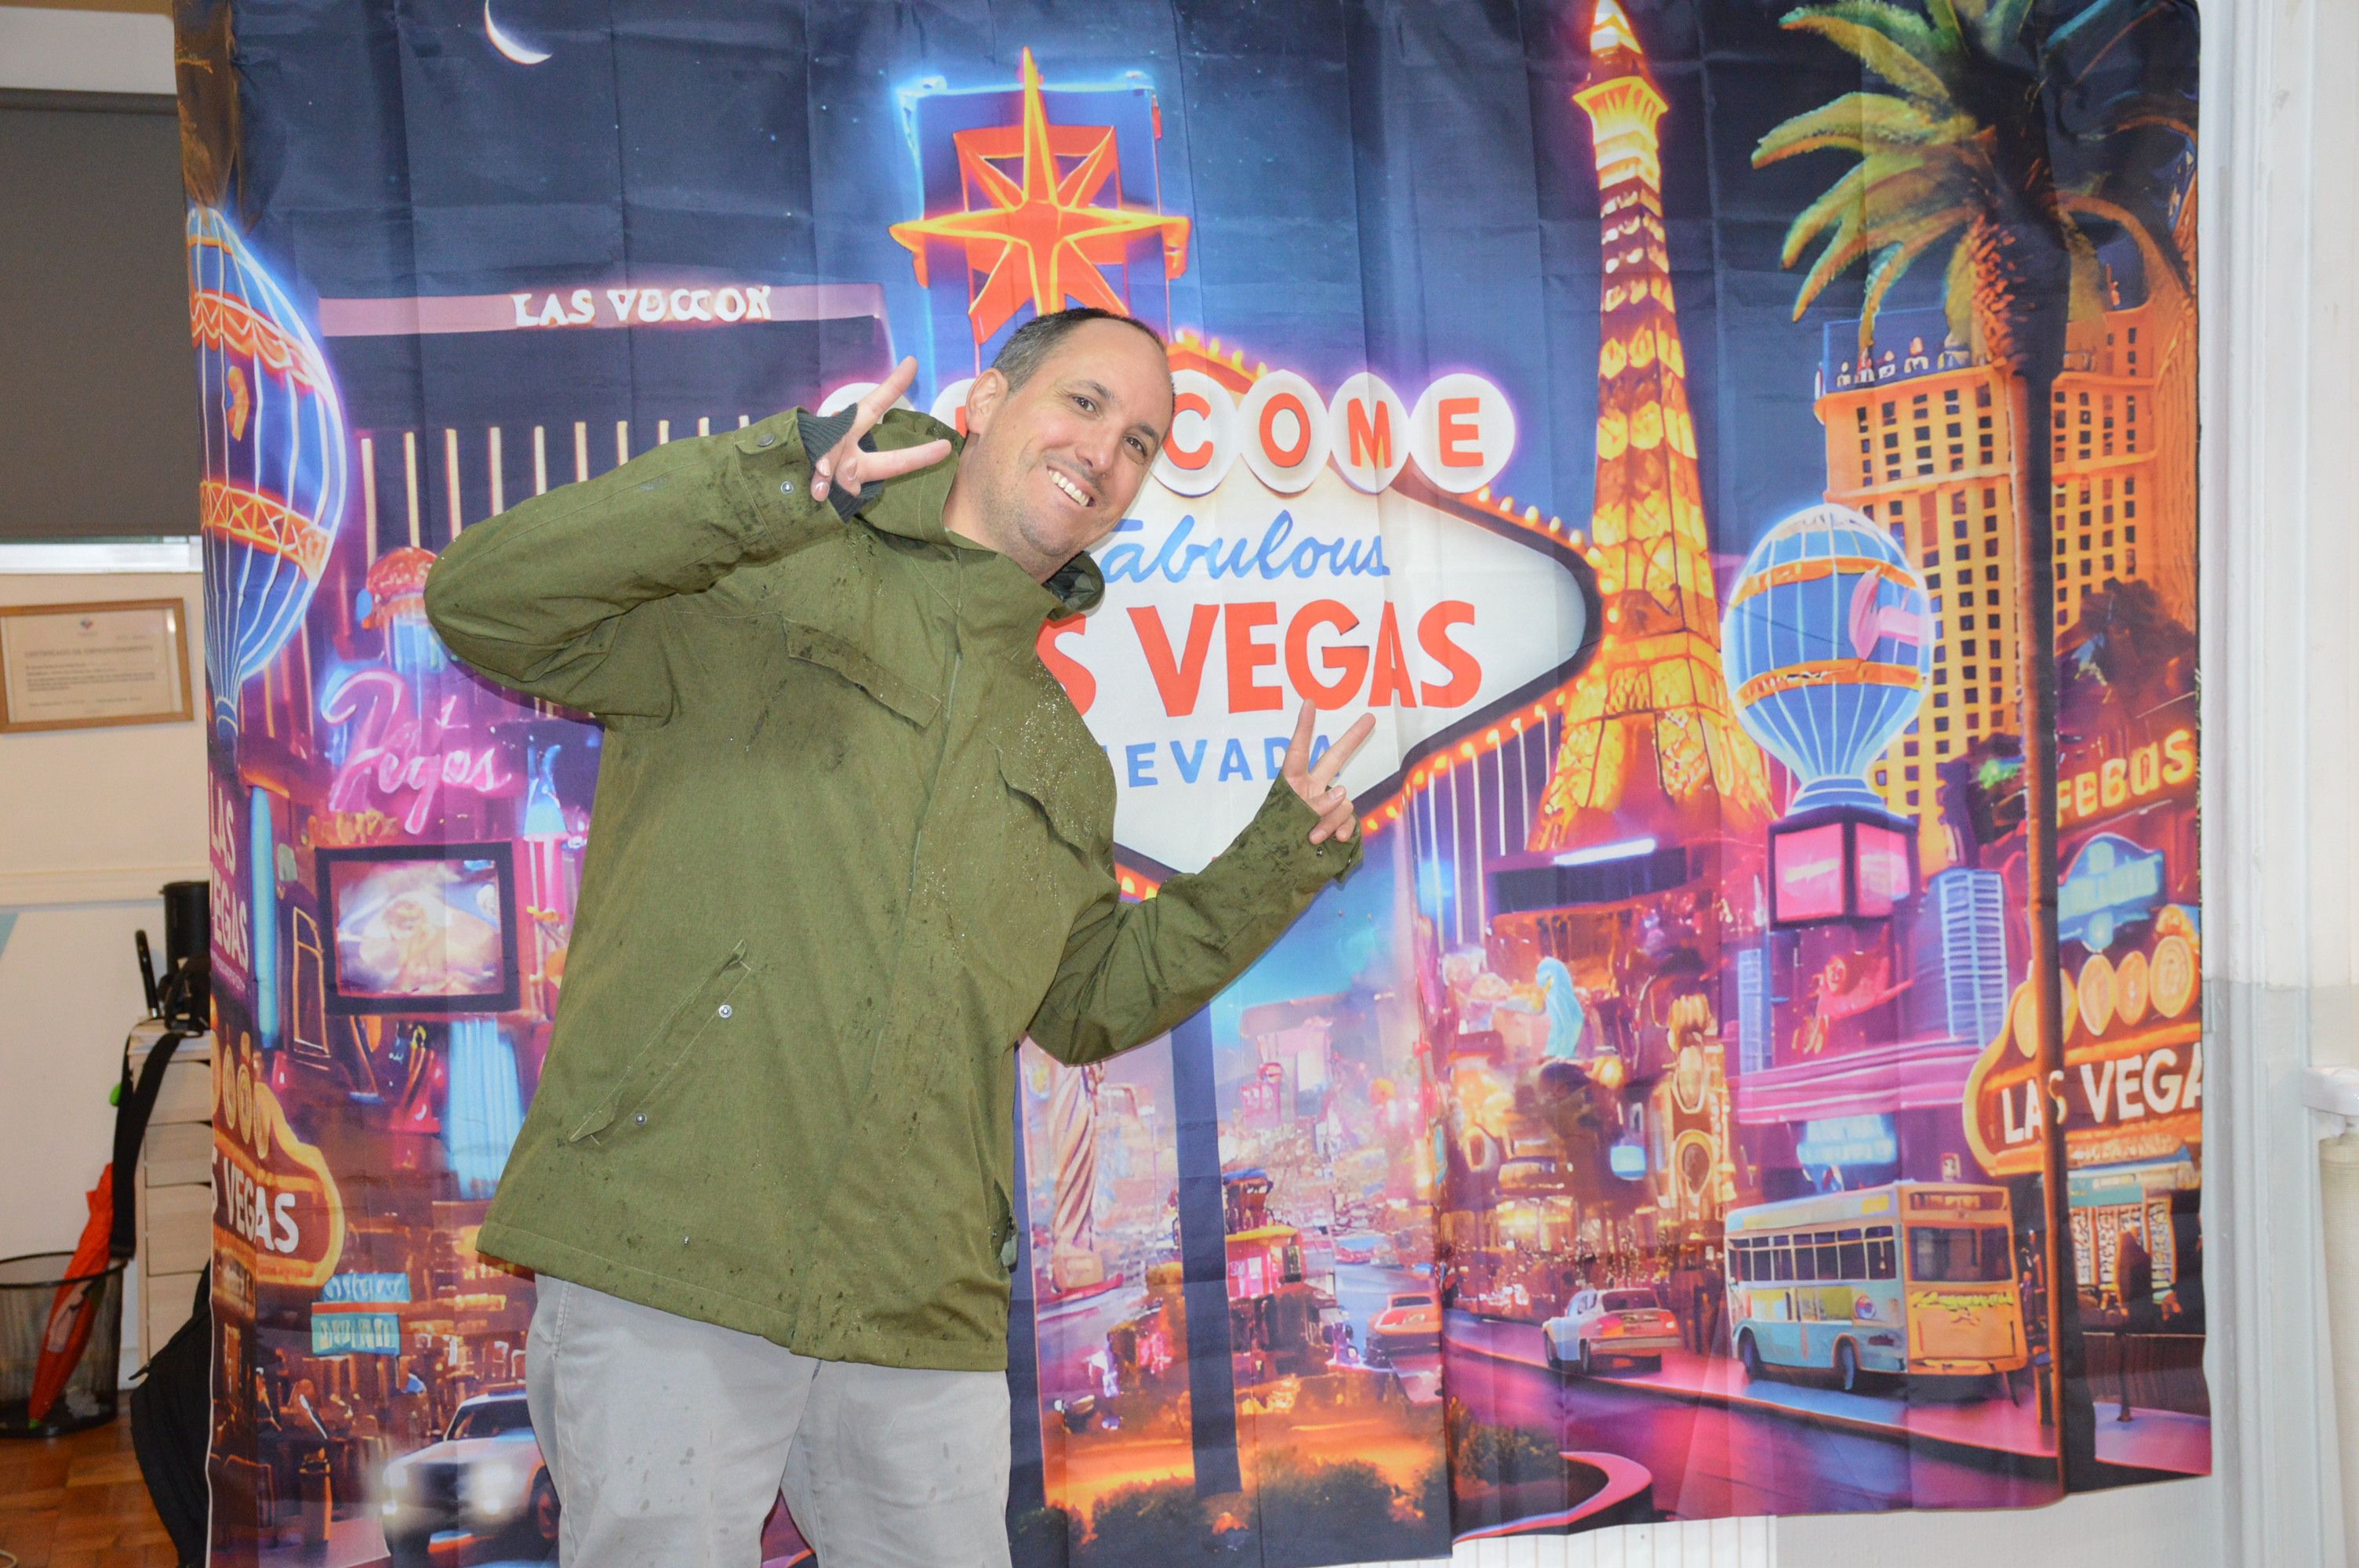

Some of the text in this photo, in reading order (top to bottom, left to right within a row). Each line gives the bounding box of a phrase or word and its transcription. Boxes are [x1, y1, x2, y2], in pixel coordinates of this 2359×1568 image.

[511, 289, 596, 328] LAS
[955, 390, 1485, 470] COME
[1125, 598, 1483, 717] VEGAS
[1099, 734, 1340, 789] EVADA
[211, 865, 249, 973] EGAS
[2001, 1069, 2068, 1145] LAS
[223, 1156, 300, 1254] VEGAS
